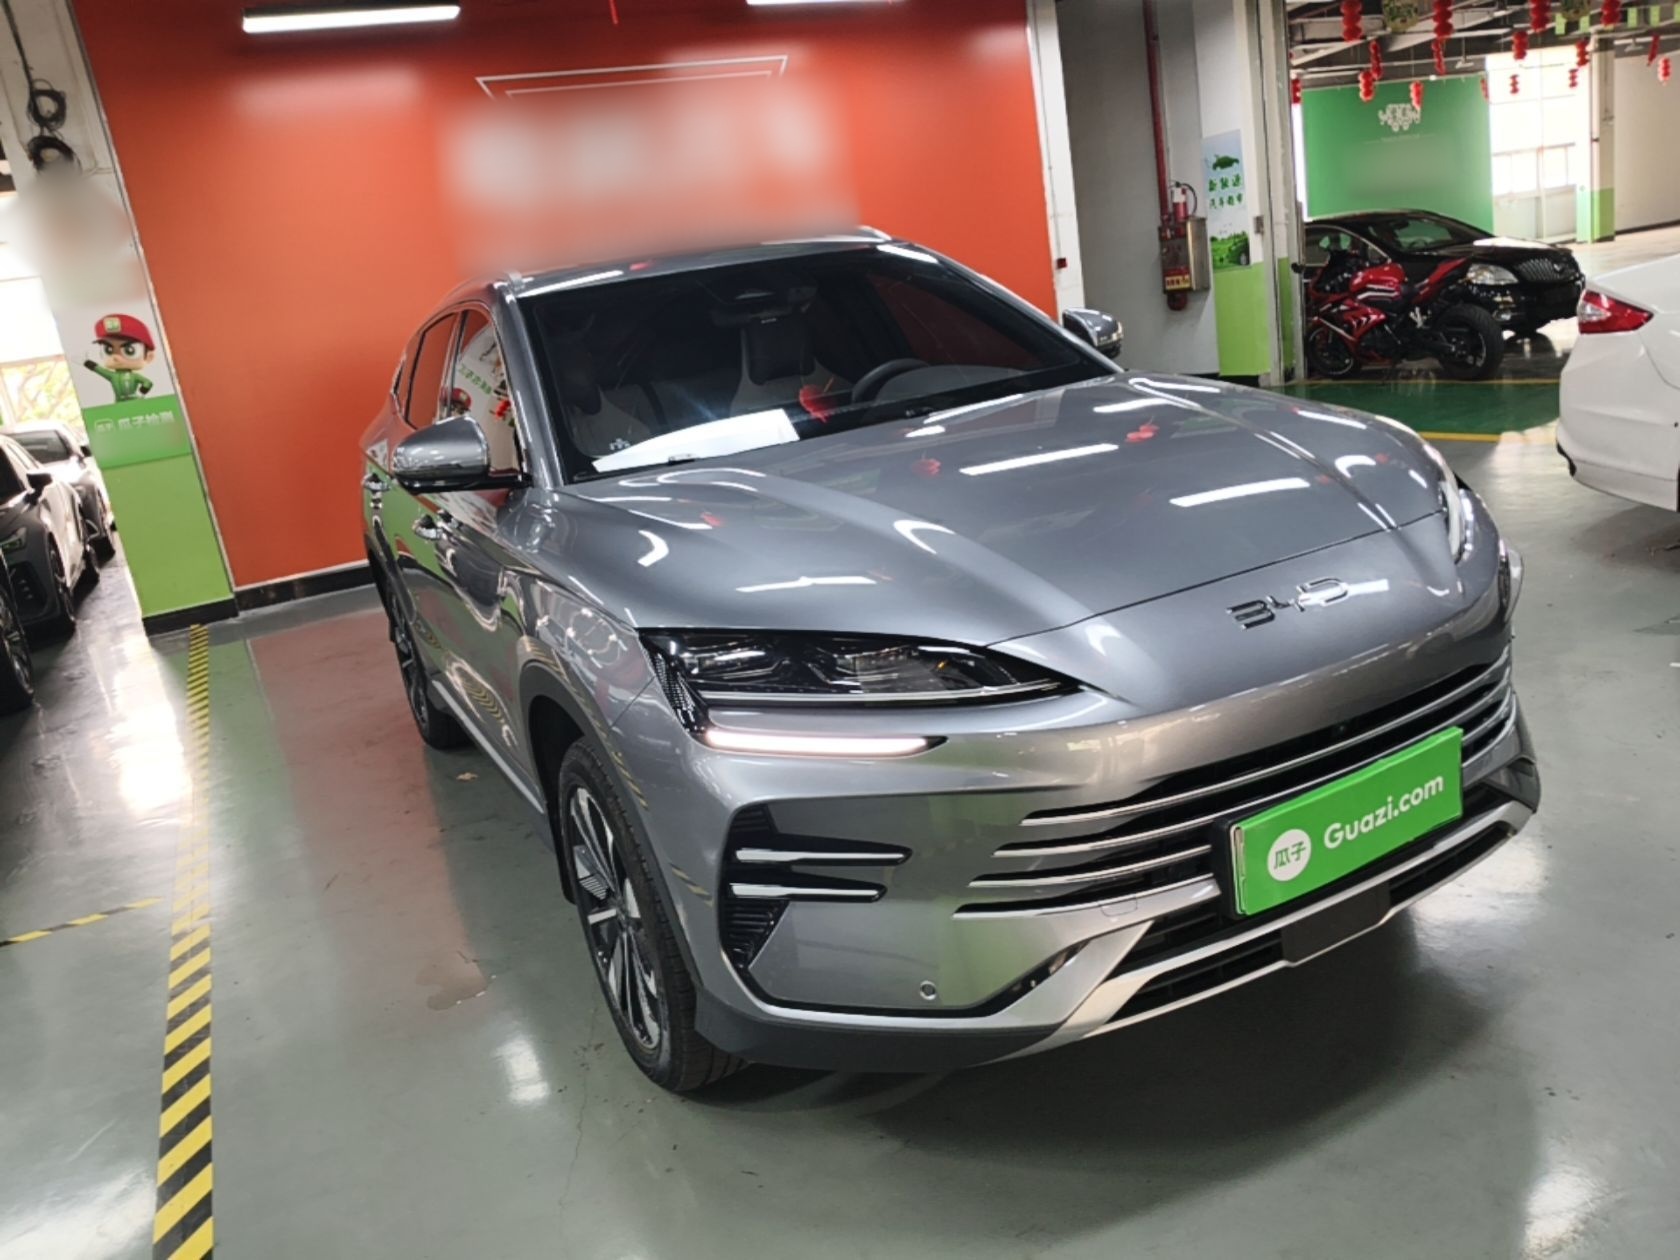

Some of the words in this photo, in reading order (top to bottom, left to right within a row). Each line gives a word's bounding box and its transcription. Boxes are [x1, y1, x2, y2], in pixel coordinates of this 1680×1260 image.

[1226, 577, 1348, 630] BYD
[1323, 775, 1445, 850] Guazi.com
[1273, 840, 1307, 870] 瓜子
